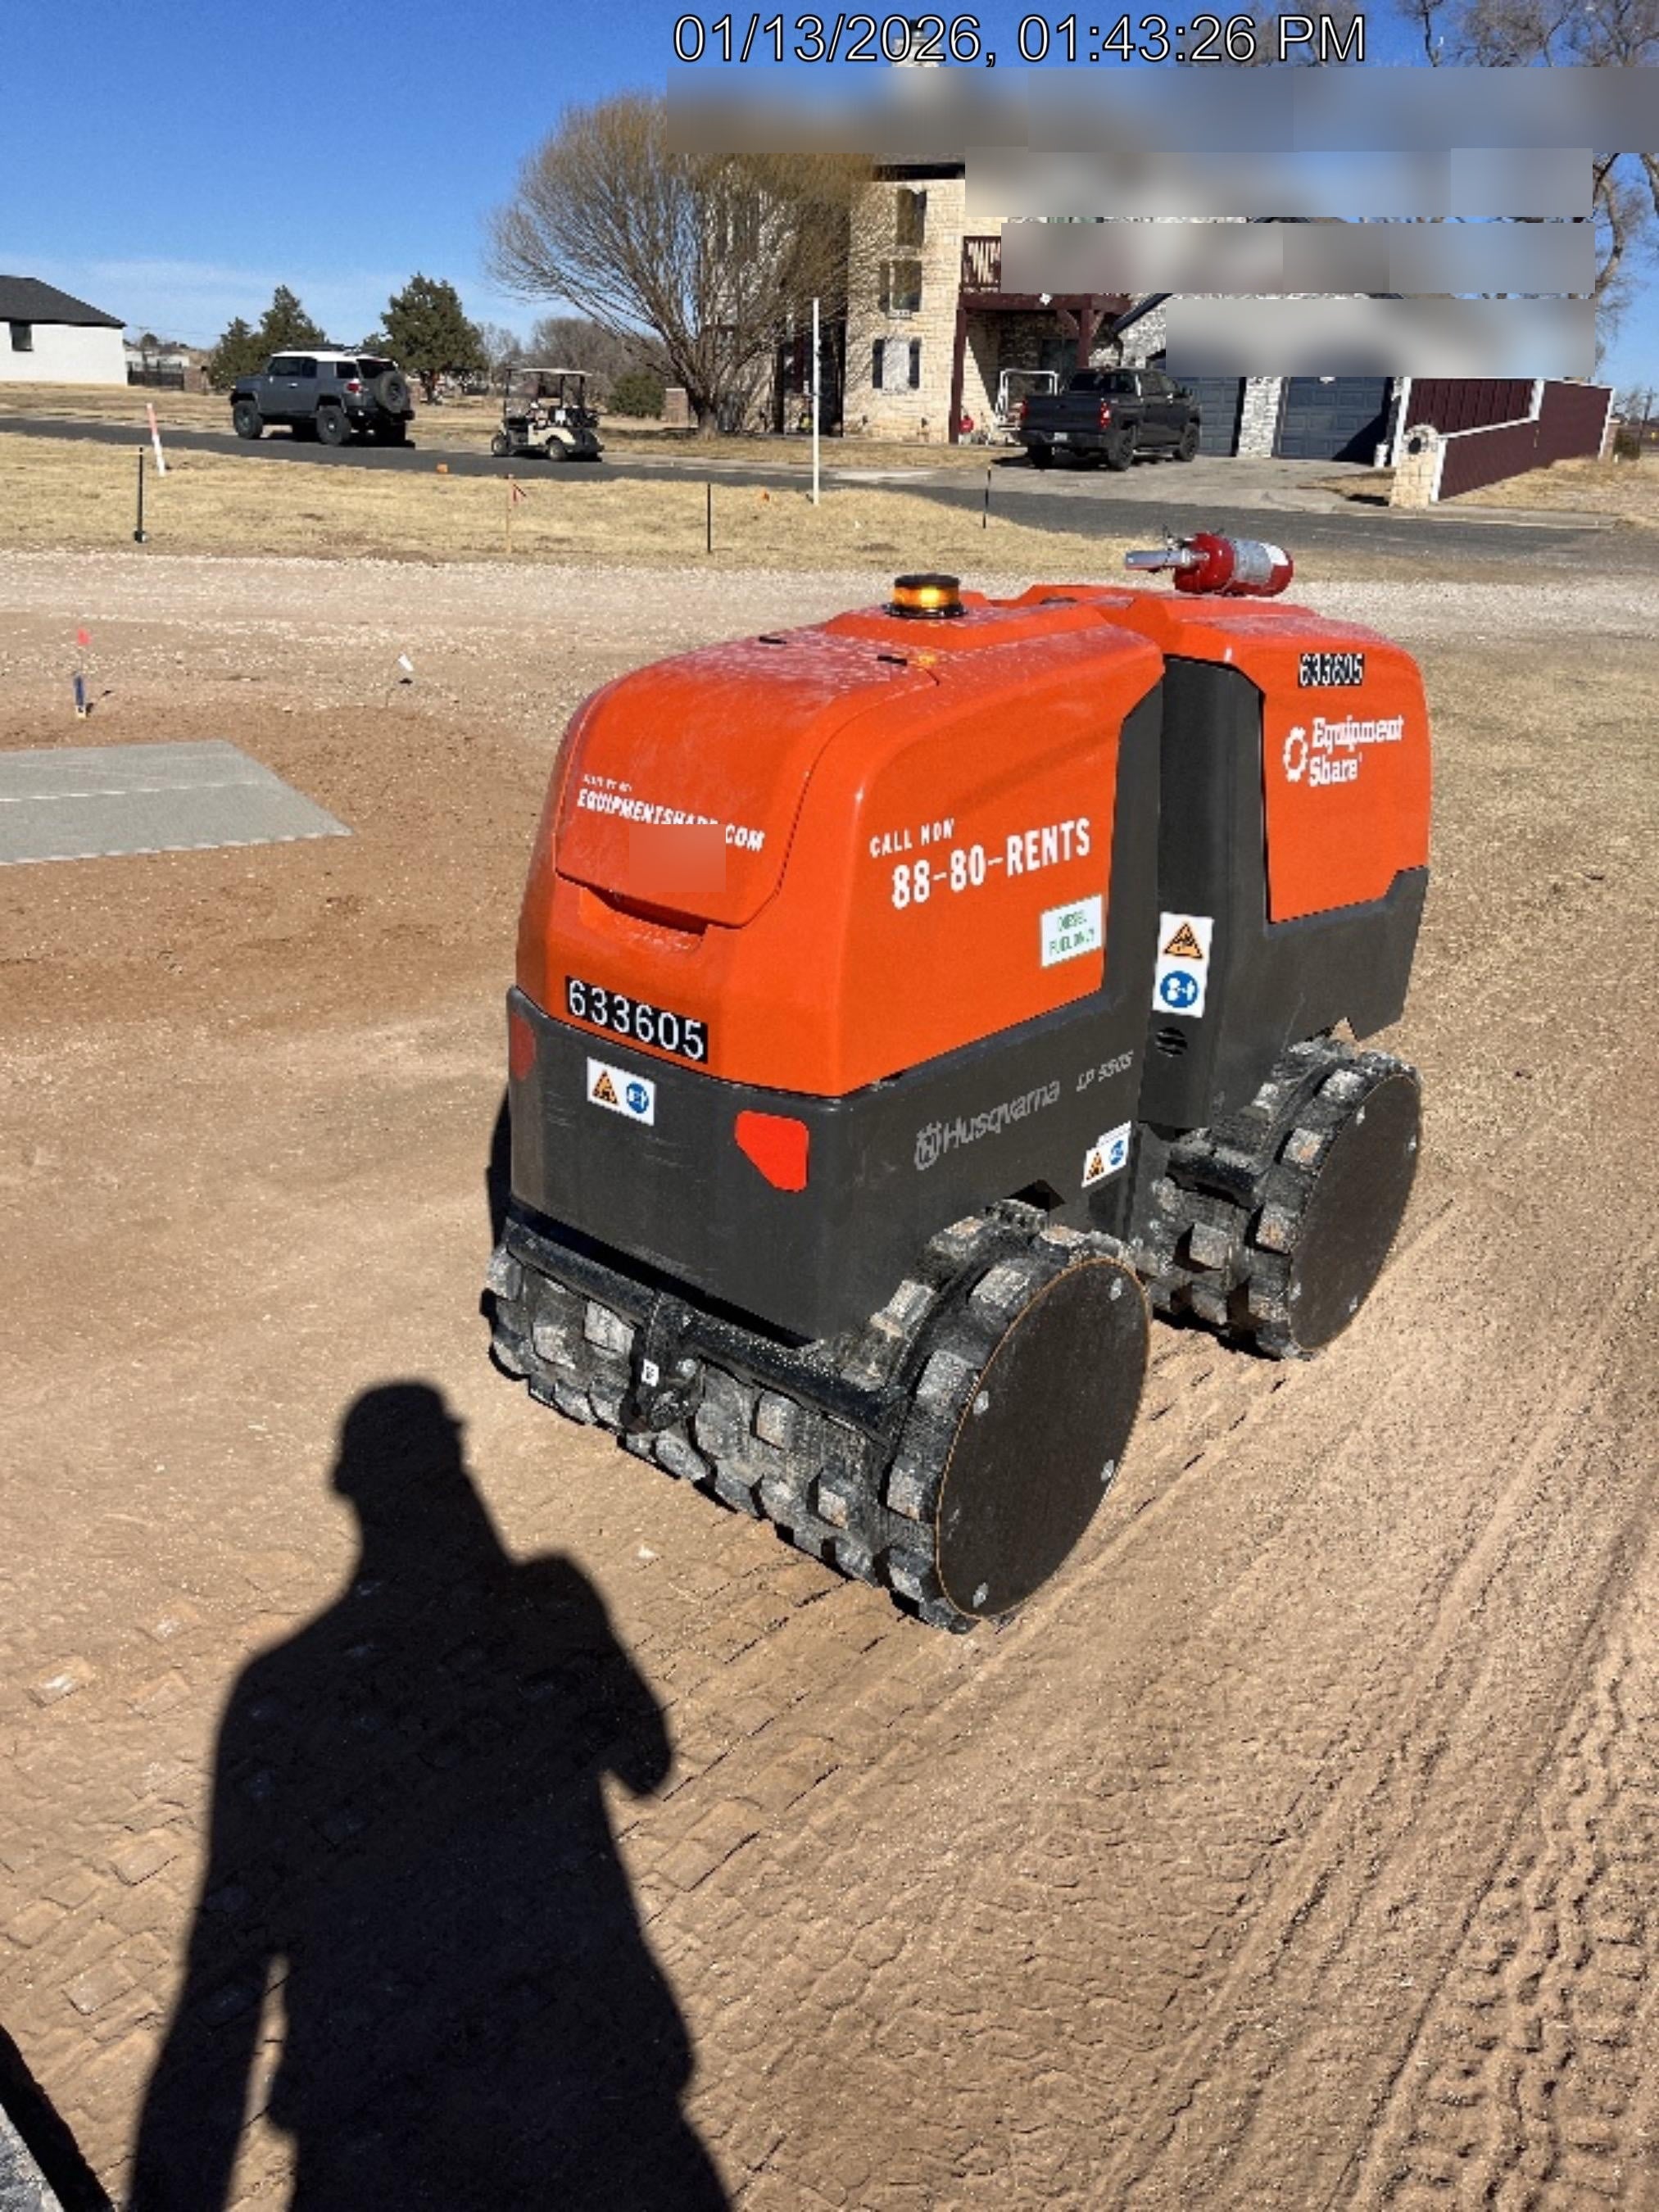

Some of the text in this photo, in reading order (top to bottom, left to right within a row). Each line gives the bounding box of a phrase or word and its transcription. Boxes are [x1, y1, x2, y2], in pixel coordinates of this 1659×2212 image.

[1299, 653, 1363, 687] 633605
[1312, 714, 1403, 755] Equipment
[1310, 752, 1358, 786] Share
[869, 818, 954, 858] CALL NOW
[891, 818, 1090, 909] 88-80-RENTS
[569, 979, 704, 1060] 633605
[943, 1080, 1060, 1153] Husqvarna
